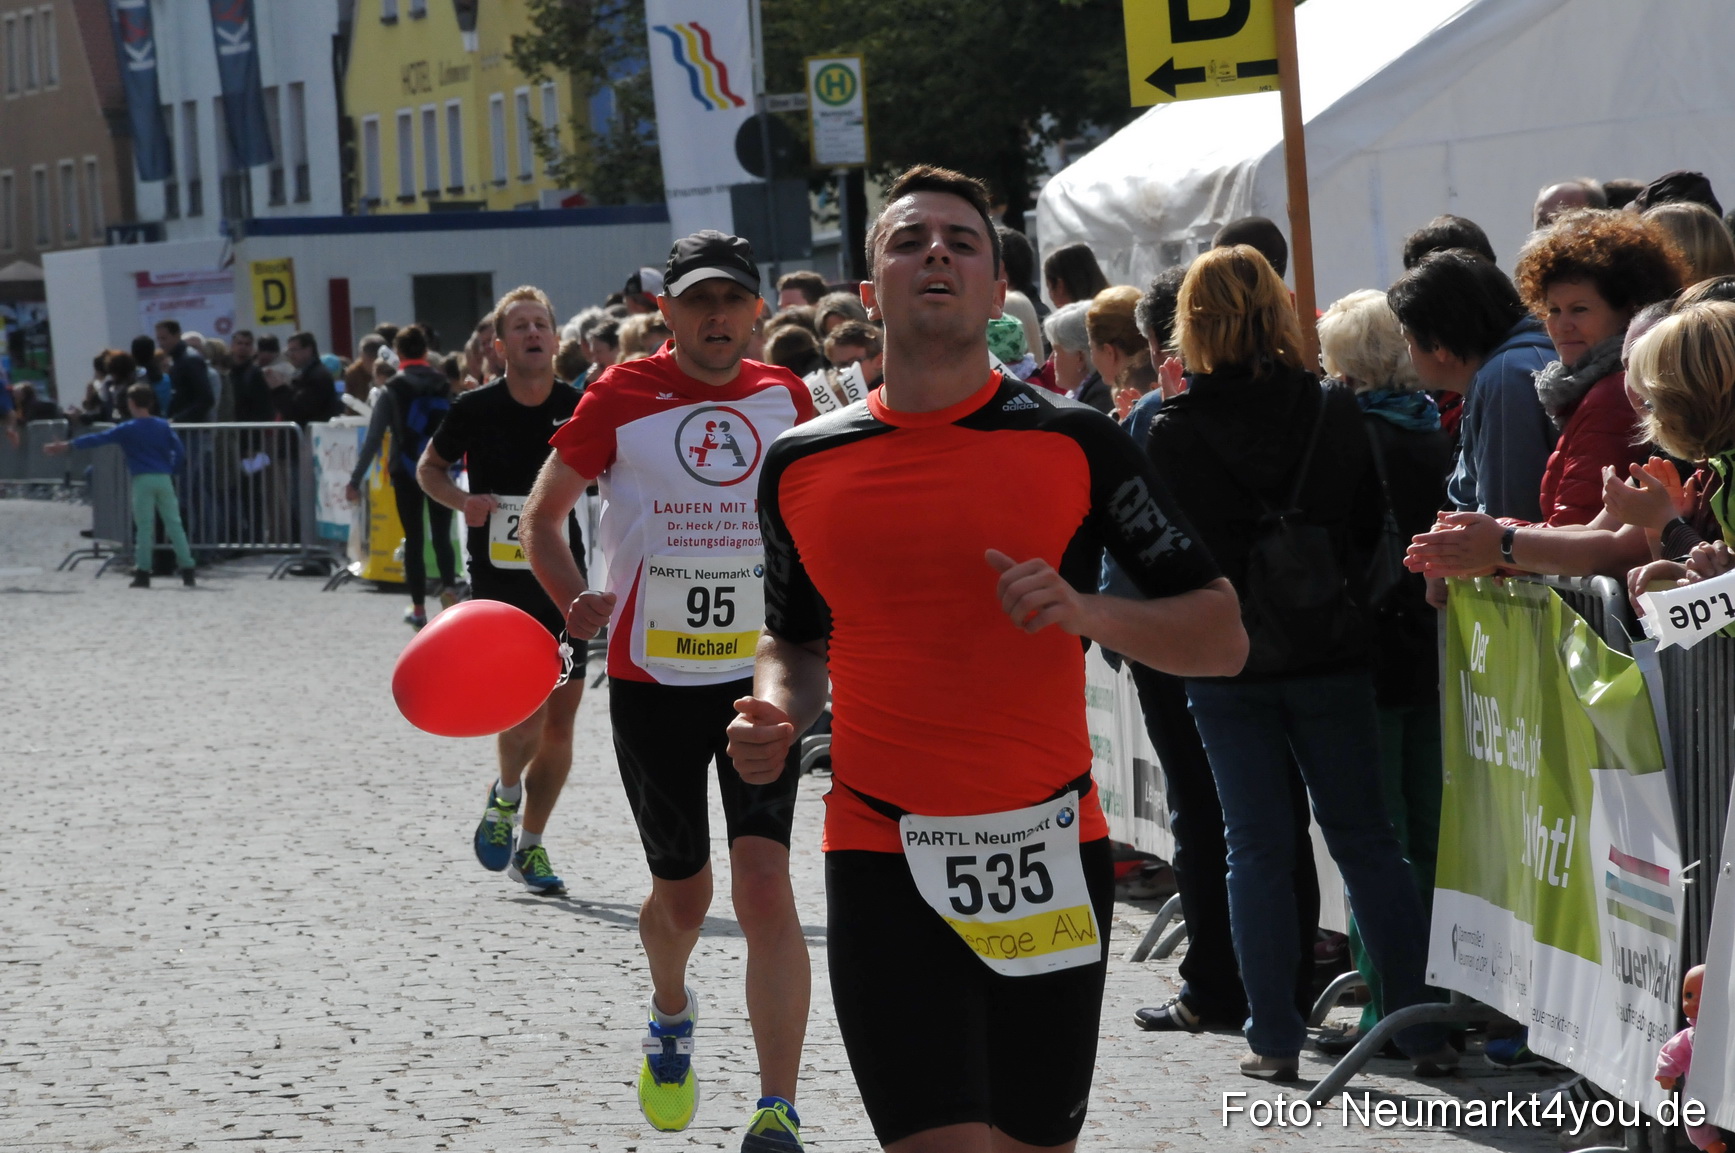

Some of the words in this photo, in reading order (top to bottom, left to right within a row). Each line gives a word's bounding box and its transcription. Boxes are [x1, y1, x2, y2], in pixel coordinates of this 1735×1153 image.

[824, 73, 846, 96] H
[262, 279, 286, 311] D
[1002, 403, 1039, 411] adidas
[496, 503, 519, 511] ARTL
[507, 515, 520, 541] 2
[667, 521, 682, 530] Dr.
[686, 521, 713, 530] Heck
[724, 521, 739, 530] Dr.
[742, 519, 760, 530] Rös
[649, 566, 692, 579] PARTL
[695, 568, 751, 579] Neumarkt
[686, 586, 735, 628] 95
[676, 637, 738, 656] Michael
[1470, 621, 1490, 673] Der
[1460, 670, 1503, 766] Neue
[906, 831, 970, 846] PARTL
[946, 842, 1054, 915] 535
[949, 921, 1036, 960] eorge
